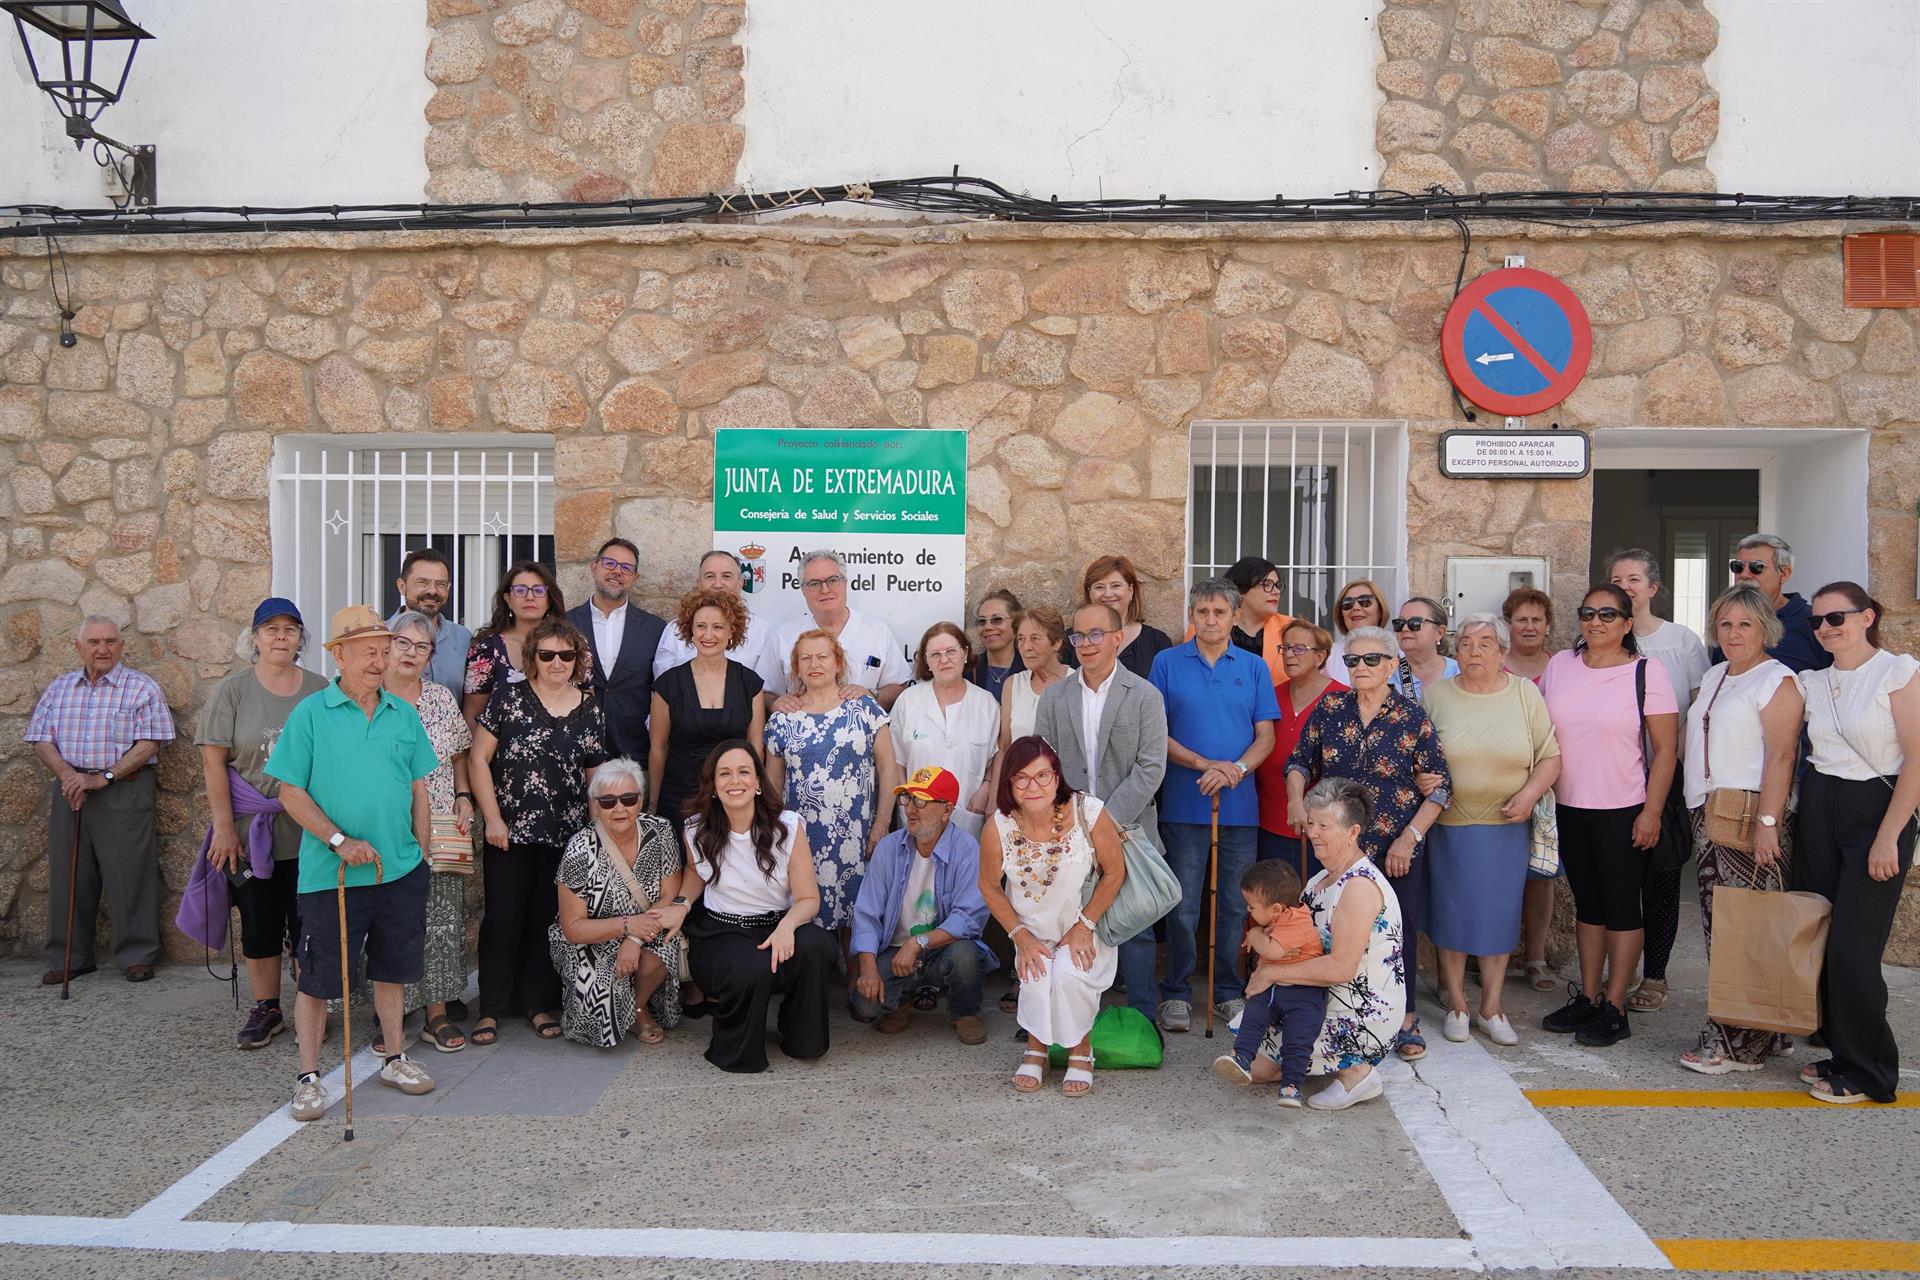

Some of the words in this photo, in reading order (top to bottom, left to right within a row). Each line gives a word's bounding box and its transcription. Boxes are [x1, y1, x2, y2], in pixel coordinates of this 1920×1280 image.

[777, 438, 818, 450] Proyecto
[823, 438, 878, 449] cofinanciado
[883, 441, 903, 452] por:
[1475, 440, 1517, 448] PROHIBIDO
[1518, 440, 1555, 448] APARCAR
[1526, 449, 1545, 457] 15:00
[1488, 459, 1529, 467] PERSONAL
[1530, 460, 1579, 468] AUTORIZADO
[724, 467, 782, 498] JUNTA
[793, 468, 814, 493] DE
[825, 468, 956, 495] EXTREMADURA
[740, 508, 790, 522] Consejería
[794, 508, 807, 519] de
[811, 508, 838, 520] Salud
[842, 512, 849, 523] y
[854, 509, 896, 521] Servicios
[901, 510, 939, 521] Sociales
[915, 548, 936, 566] de
[850, 574, 876, 592] del
[886, 574, 943, 593] Puerto
